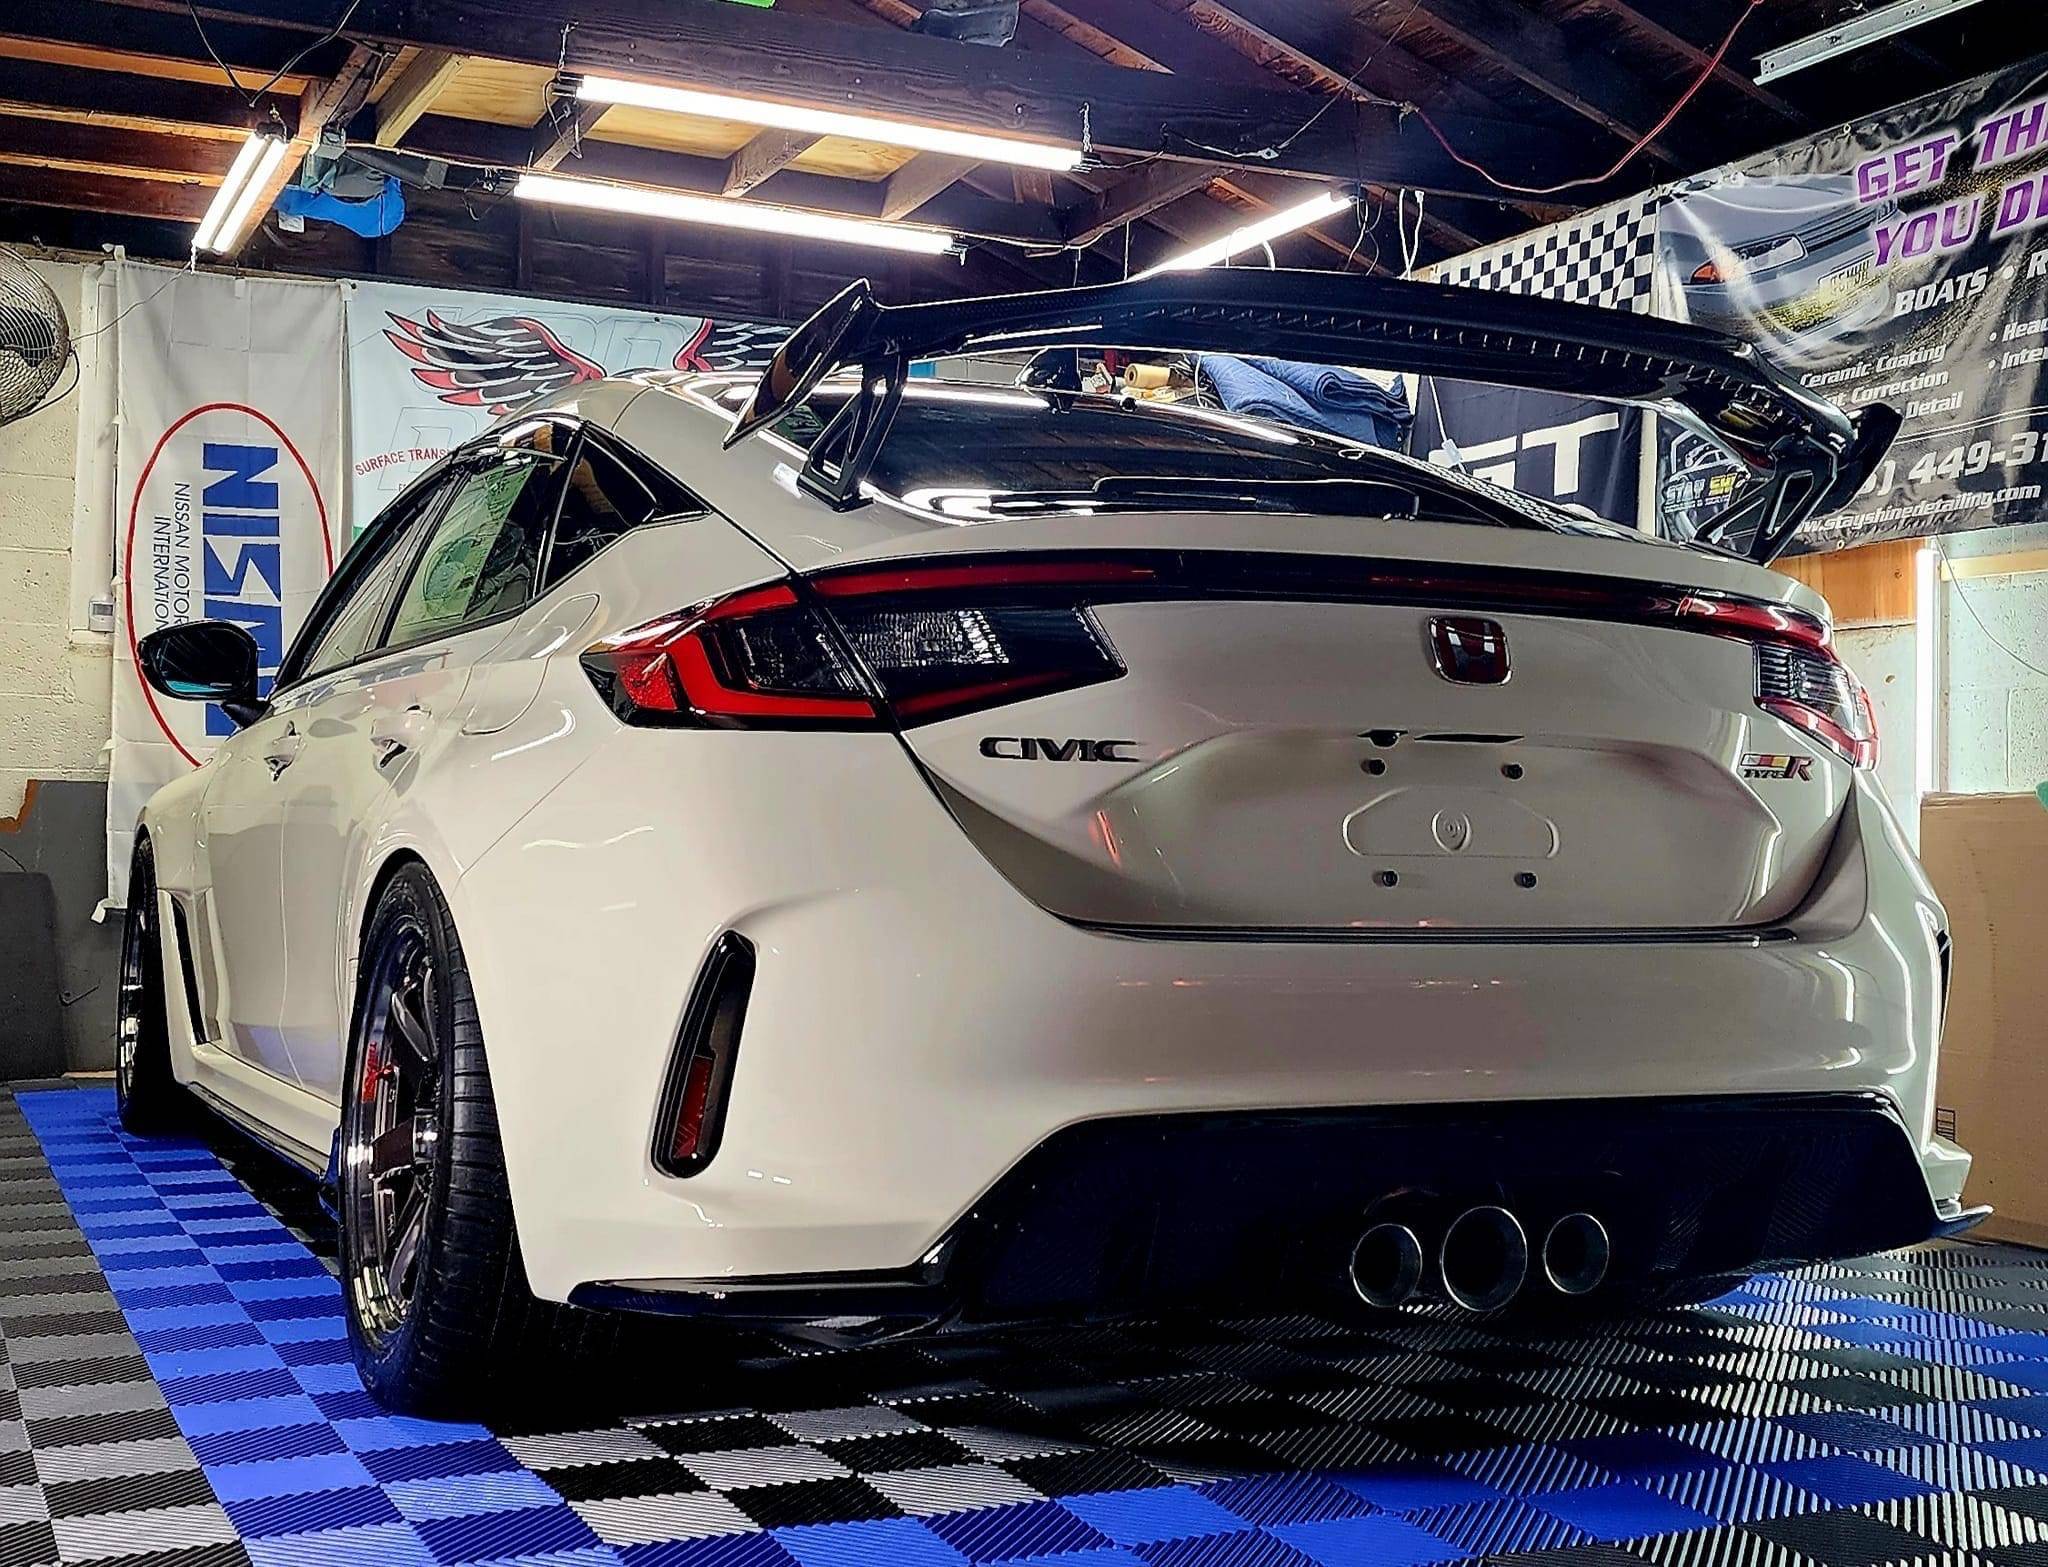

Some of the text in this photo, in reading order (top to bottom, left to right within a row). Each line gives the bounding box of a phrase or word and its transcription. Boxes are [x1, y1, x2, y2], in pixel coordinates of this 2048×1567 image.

[1857, 102, 2048, 204] GET TH
[1874, 199, 1980, 267] YOU
[1894, 266, 1989, 318] BOATS
[1800, 343, 1947, 388] Ceramic Coating
[1850, 371, 1949, 404] Correction
[1905, 391, 1965, 420] Detail
[355, 450, 406, 476] SURFACE
[174, 482, 190, 549] NISSAN
[979, 737, 1140, 763] CIVIC
